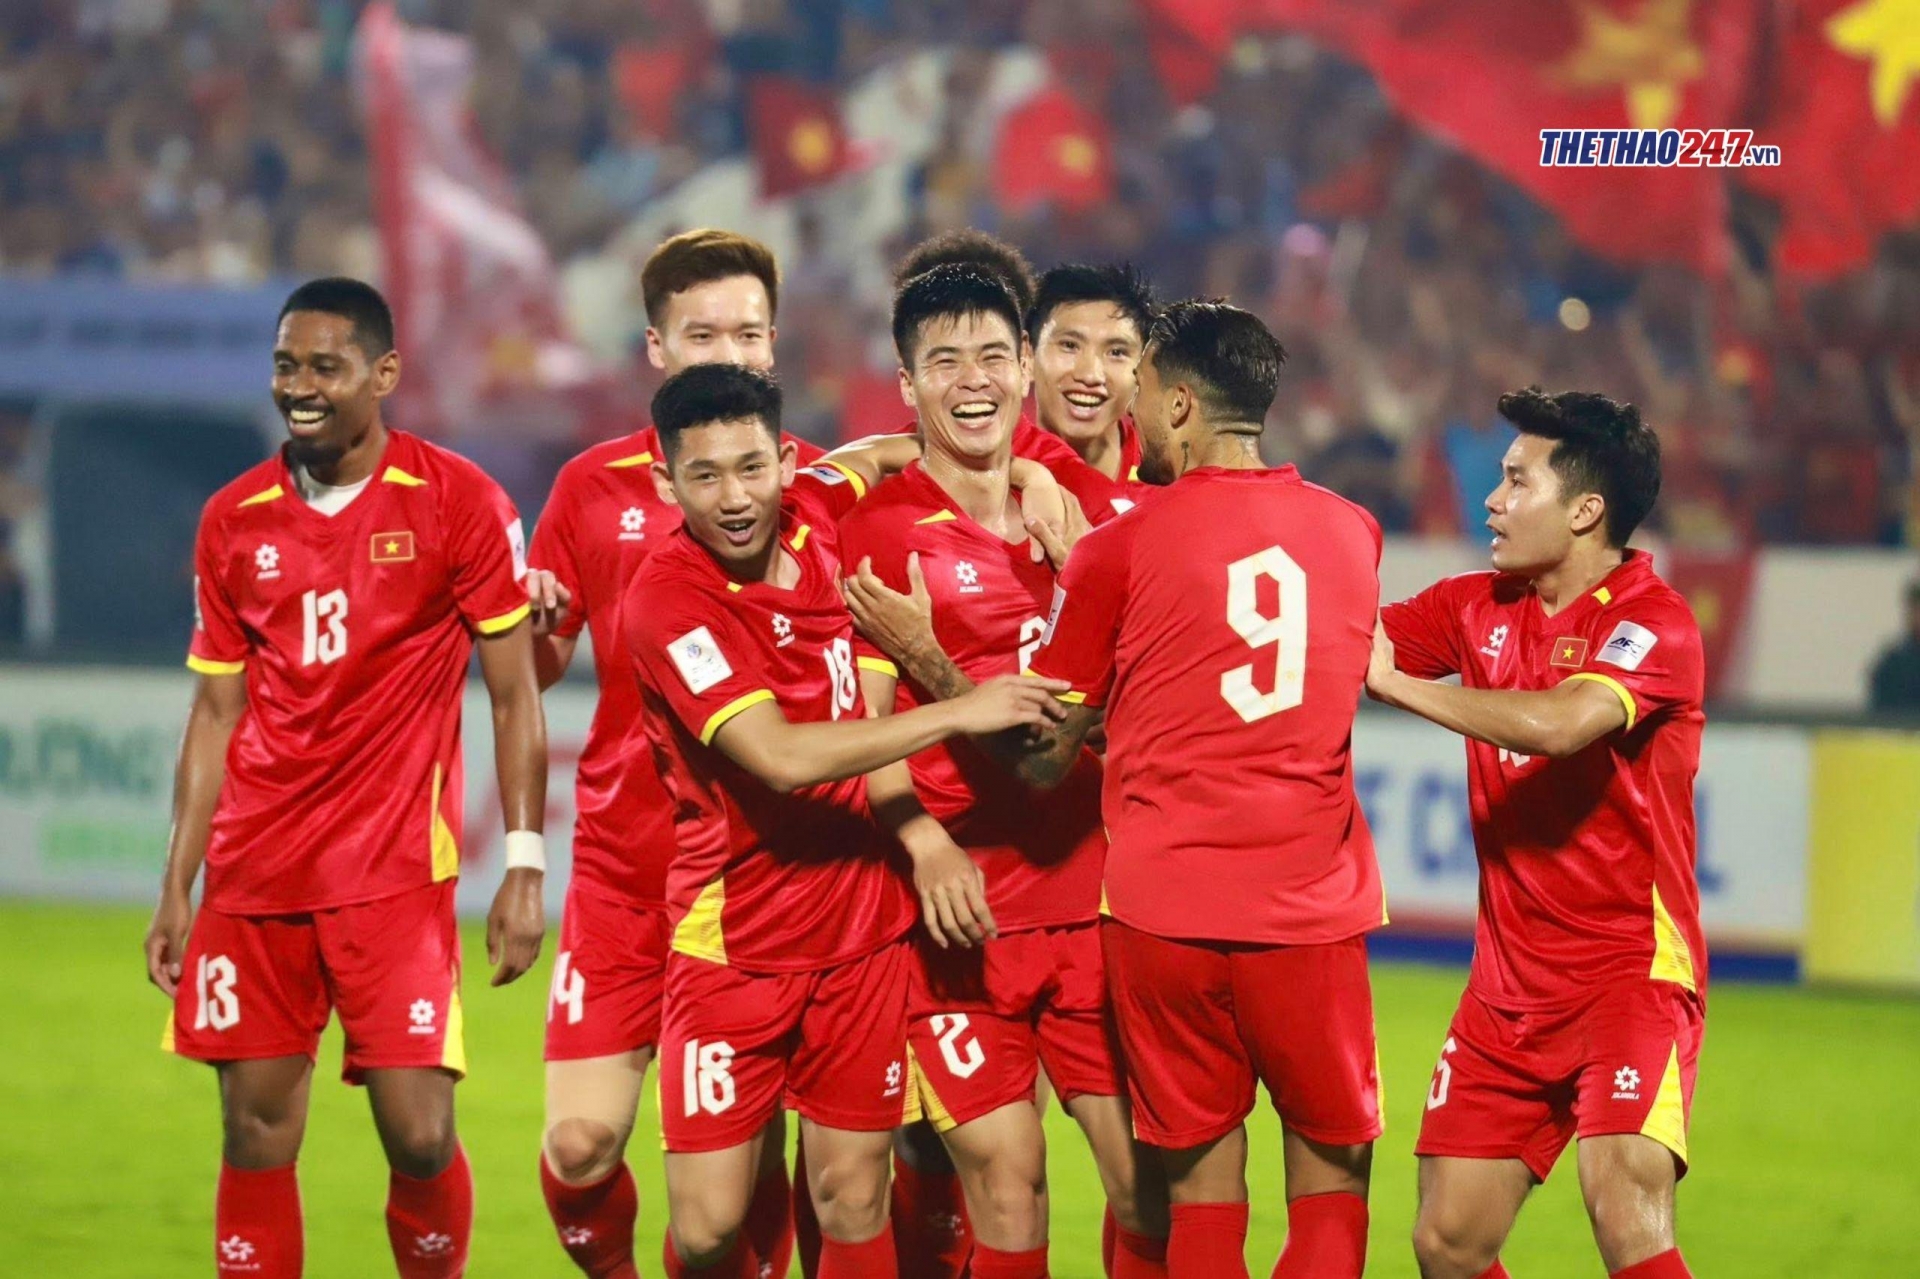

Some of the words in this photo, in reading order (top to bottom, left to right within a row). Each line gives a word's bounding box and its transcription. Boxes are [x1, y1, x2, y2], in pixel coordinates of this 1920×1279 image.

[302, 588, 348, 666] 13
[1220, 544, 1307, 723] 9
[823, 637, 857, 721] 18
[194, 953, 240, 1031] 13
[684, 1038, 736, 1118] 18
[929, 1012, 986, 1079] 2
